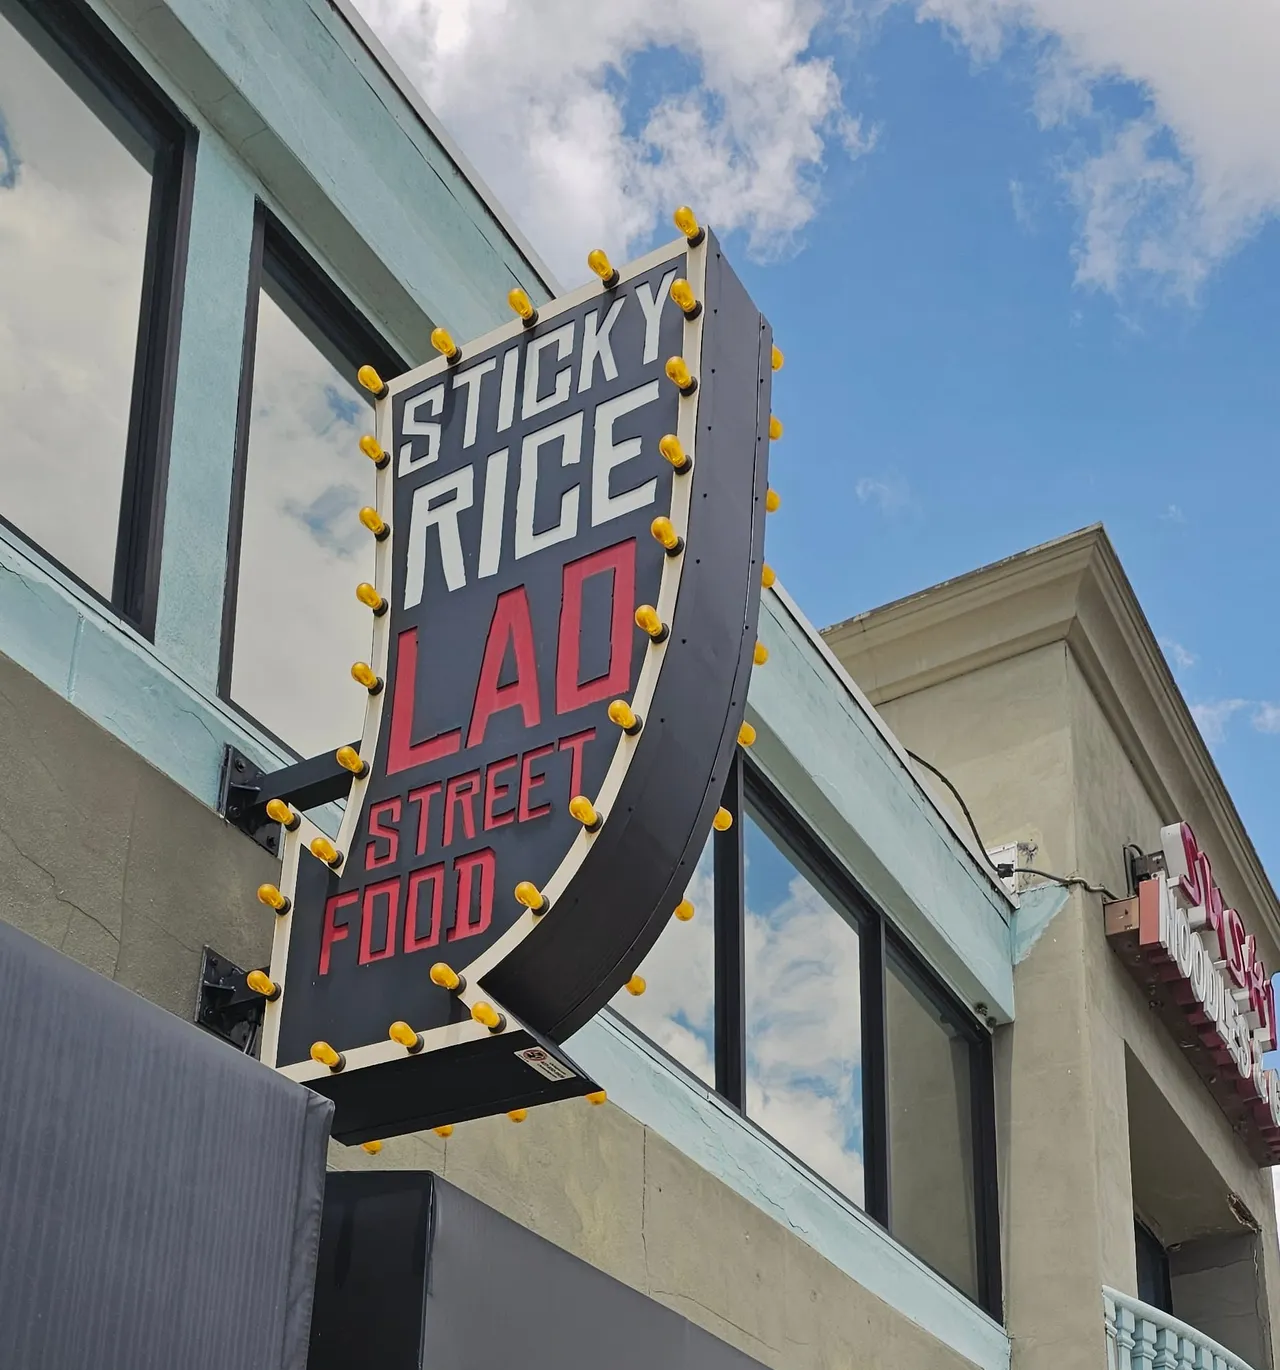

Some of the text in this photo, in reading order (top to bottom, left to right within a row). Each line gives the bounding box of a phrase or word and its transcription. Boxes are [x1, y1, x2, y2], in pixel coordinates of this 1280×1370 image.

[398, 268, 678, 478] STICKY
[404, 379, 660, 611] RICE
[386, 537, 637, 776] LAO
[365, 727, 597, 871] STREET
[319, 847, 496, 976] FOOD
[1159, 871, 1252, 1080] NOODLES
[1165, 820, 1278, 1050] SUSHI
